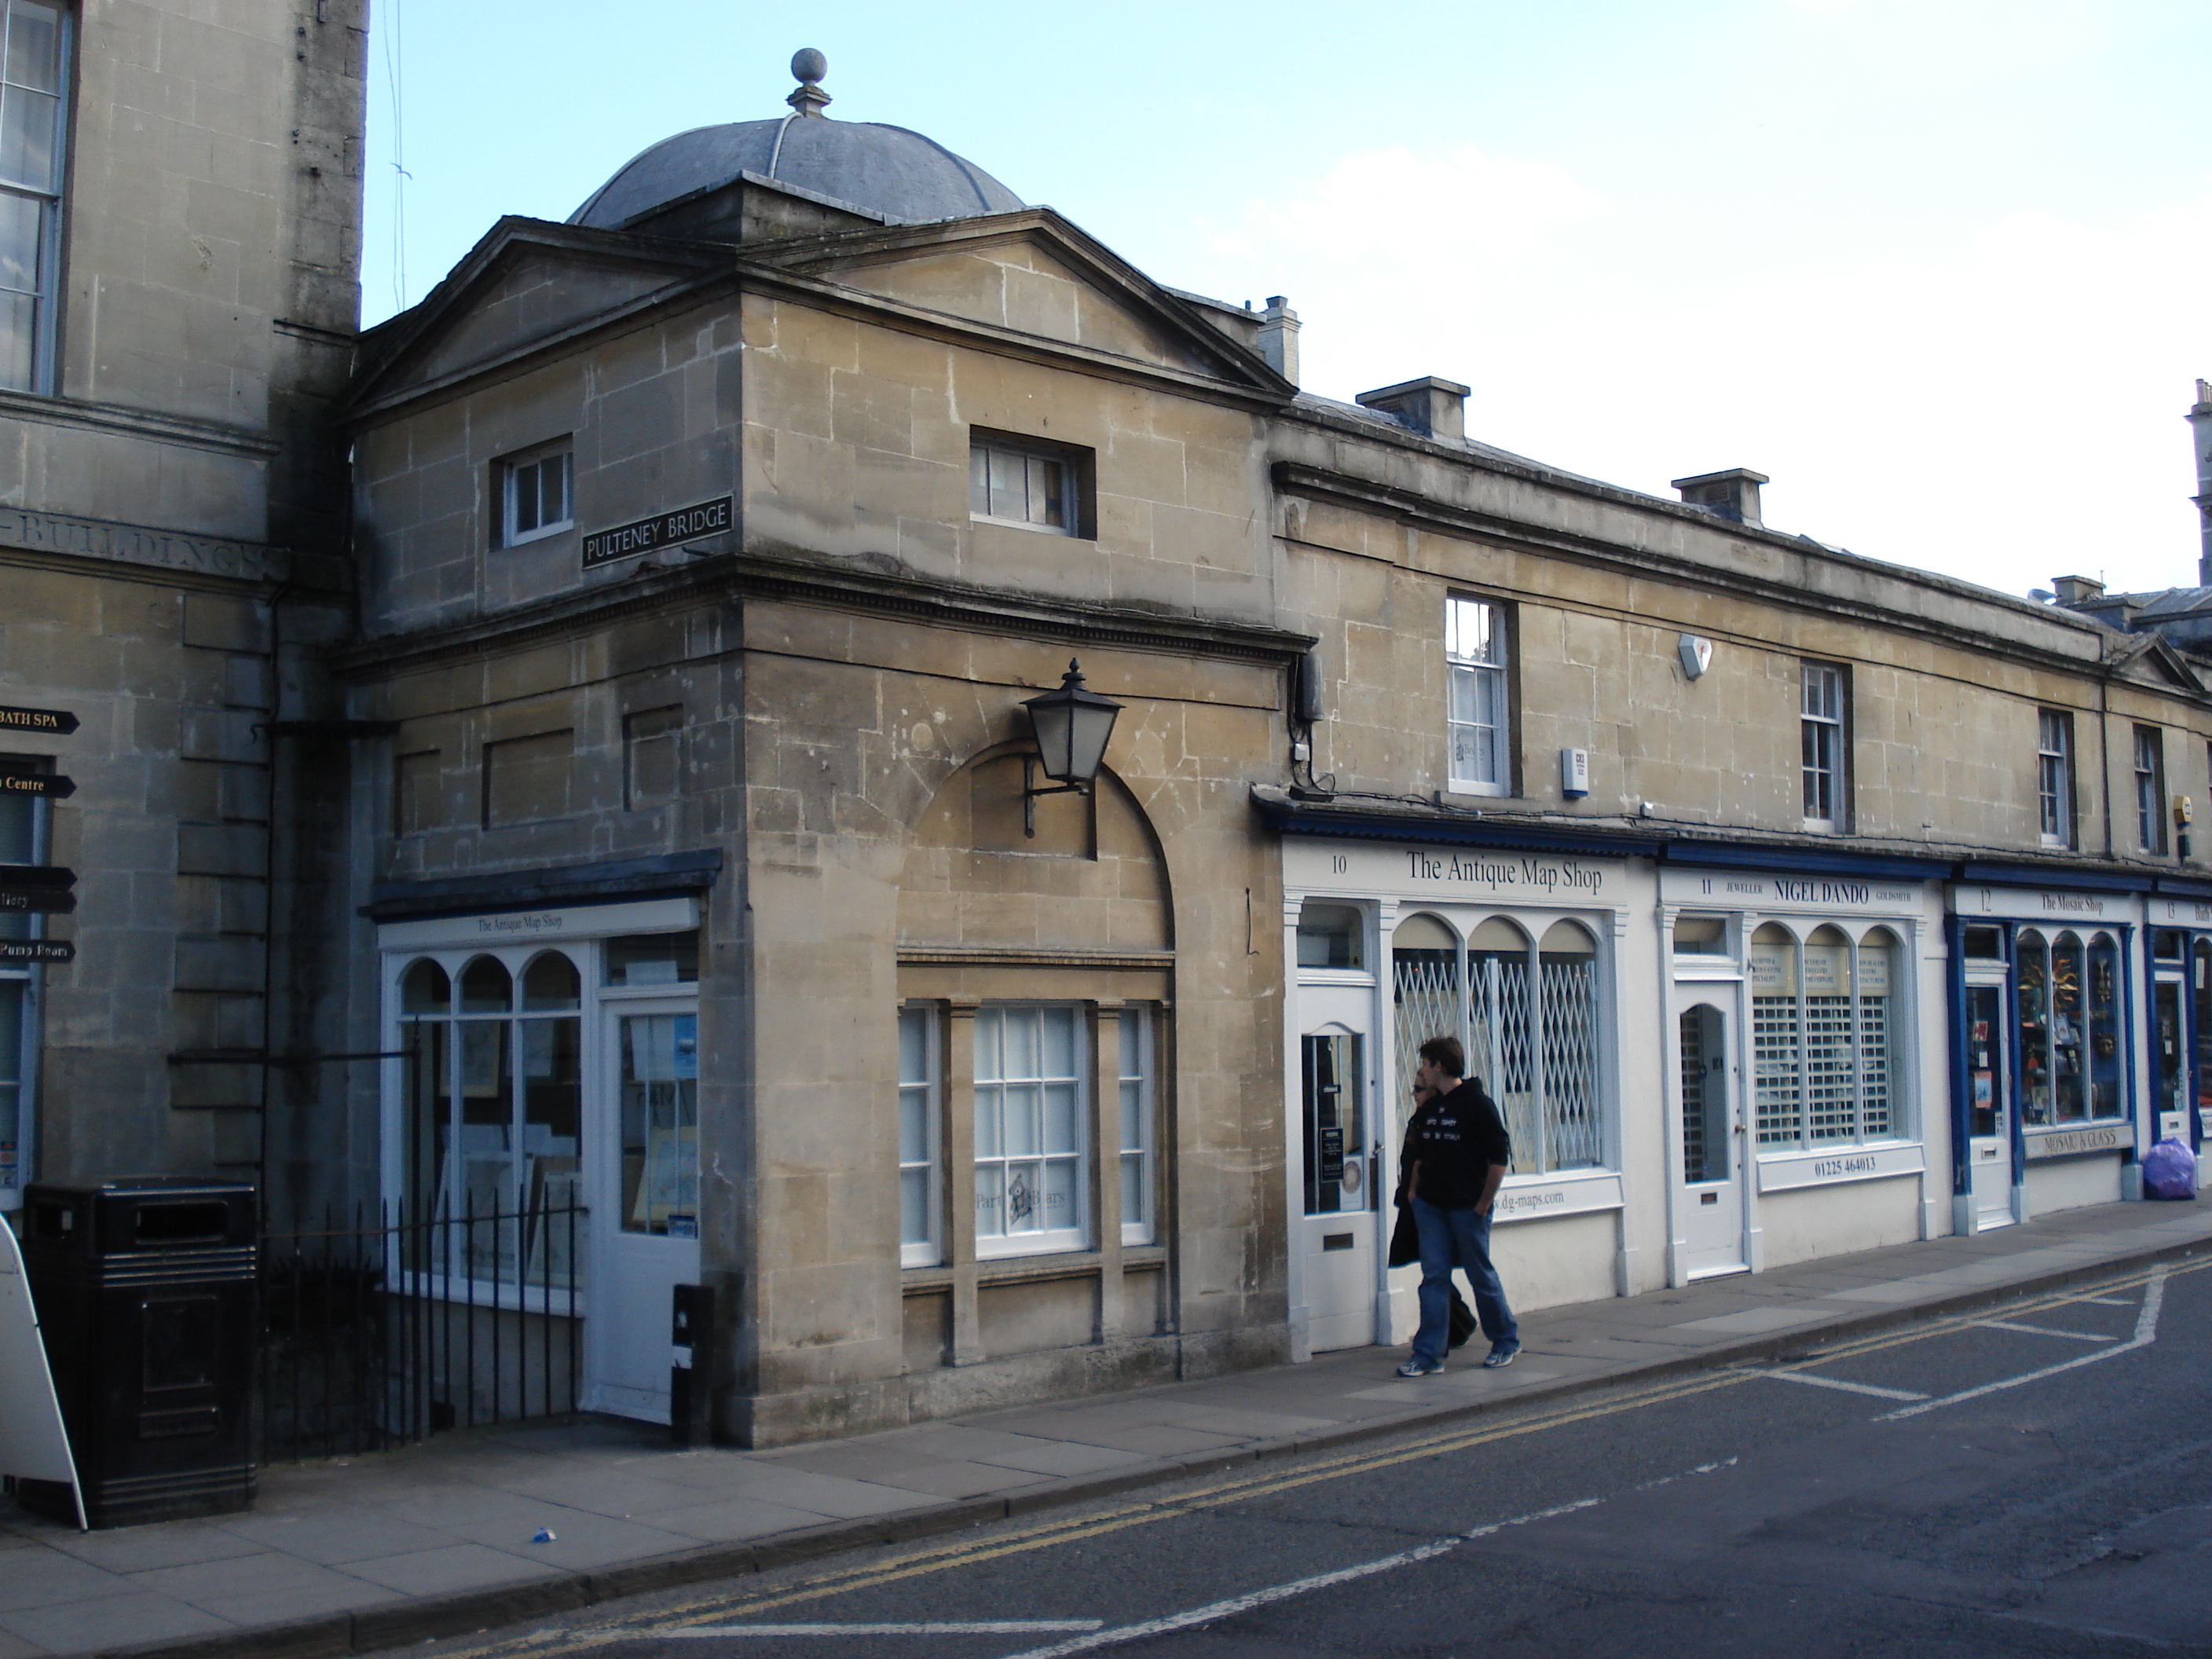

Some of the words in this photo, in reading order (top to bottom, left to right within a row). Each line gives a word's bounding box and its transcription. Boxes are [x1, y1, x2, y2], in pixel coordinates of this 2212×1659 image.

[587, 520, 661, 561] PULTENEY
[668, 503, 727, 539] BRIDGE
[34, 713, 57, 727] SPA
[5, 776, 44, 791] Centre
[1333, 855, 1347, 874] 10
[1407, 851, 1442, 880] The
[1447, 854, 1516, 891] Antique
[1521, 859, 1558, 894] Map
[1562, 862, 1602, 895] Shop
[1702, 879, 1711, 895] 11
[1727, 882, 1763, 894] JEWELLER
[1774, 880, 1818, 902] NIGEL
[1822, 883, 1869, 904] DANDO
[1876, 891, 1911, 902] GOLDSMITH
[1981, 889, 1992, 912] 12
[2042, 893, 2056, 910] The
[2057, 895, 2084, 912] Mosaic
[2085, 897, 2104, 917] Shop
[478, 918, 492, 932] The
[493, 918, 522, 933] Antique
[524, 915, 541, 932] Map
[542, 914, 562, 930] Shop
[37, 944, 68, 957] Room
[2045, 1133, 2077, 1152] MOSAIC
[1815, 1160, 1842, 1177] 01225
[1844, 1156, 1876, 1174] 464013
